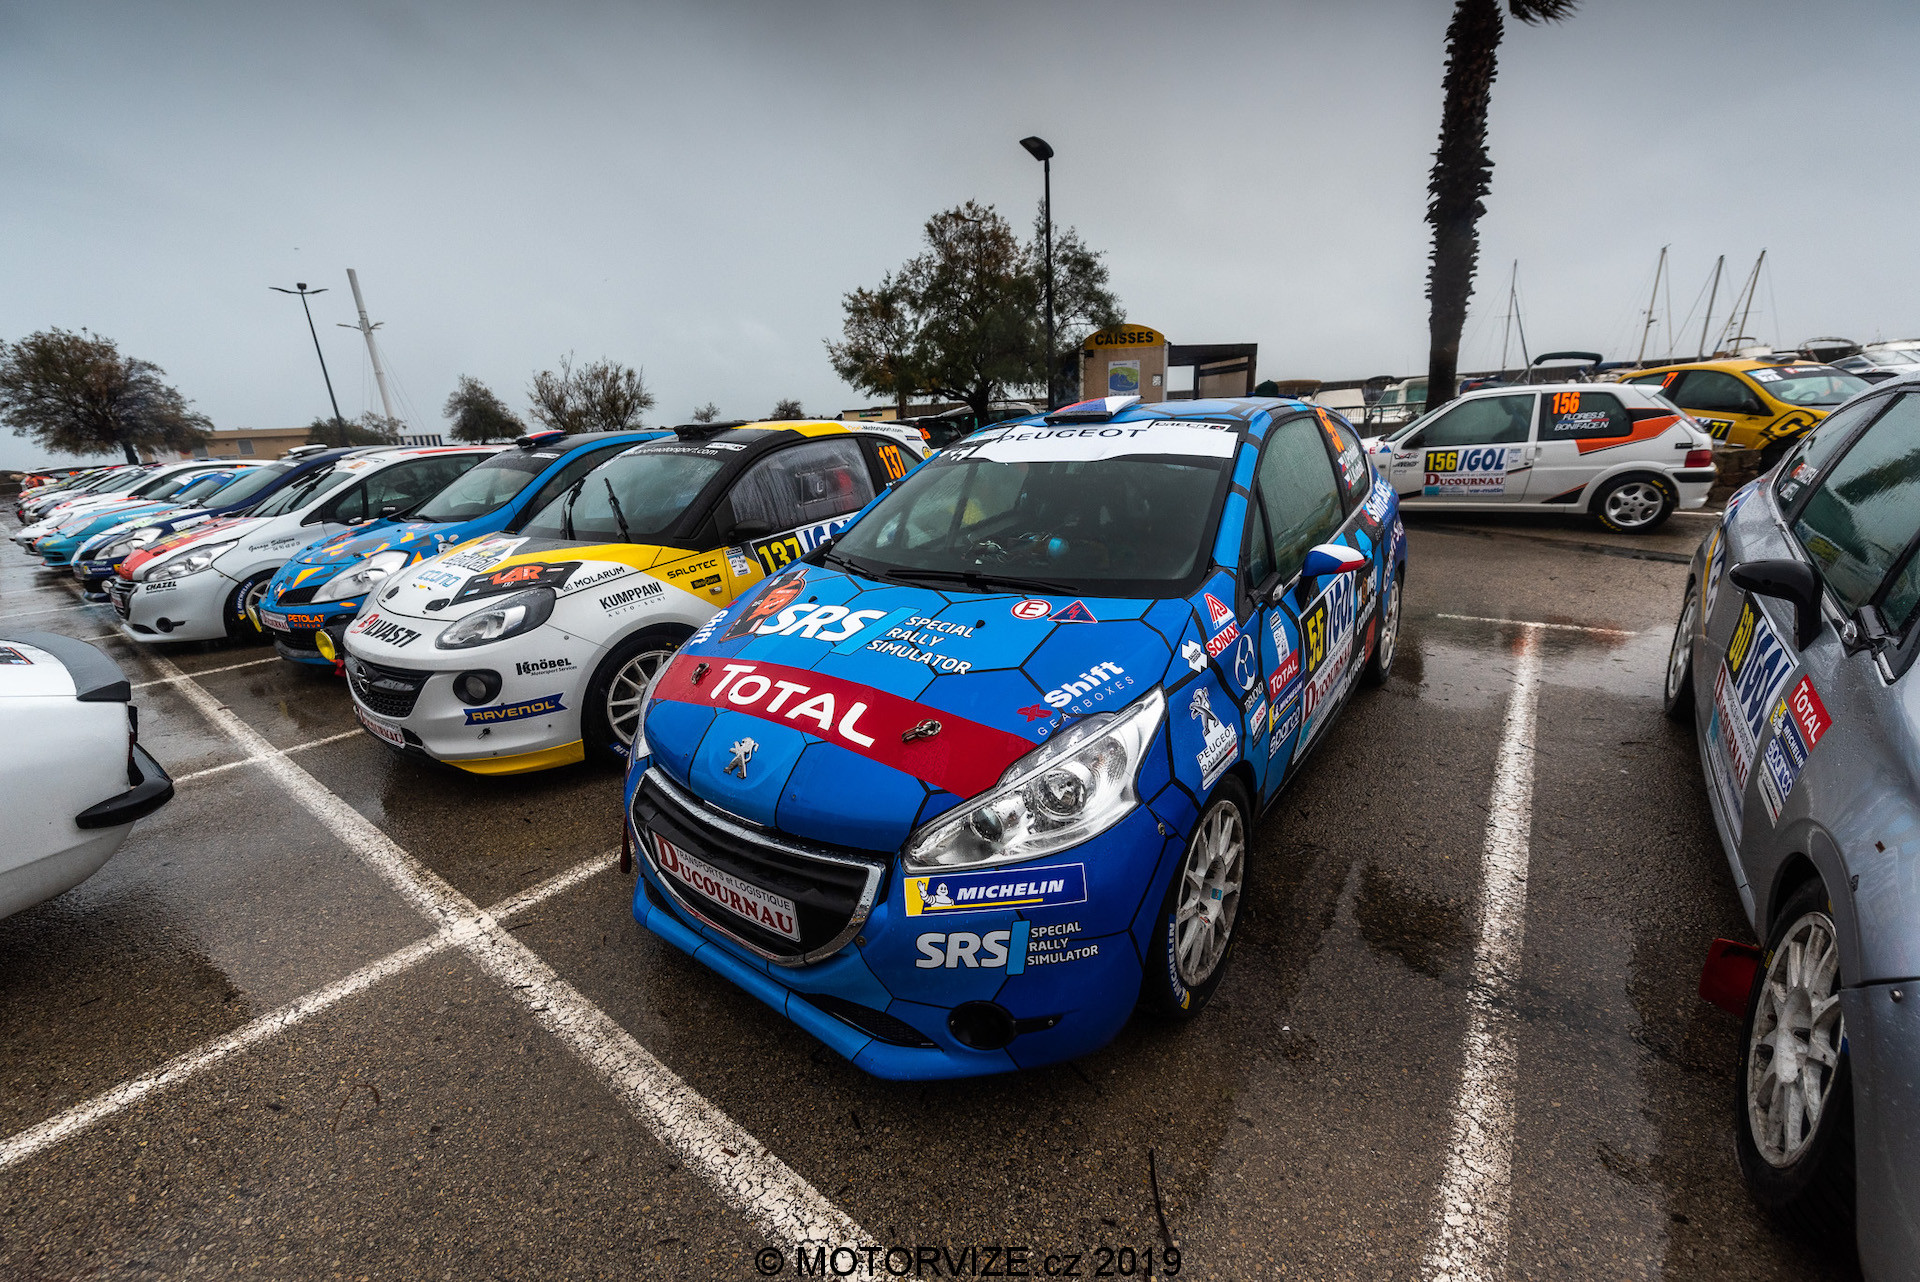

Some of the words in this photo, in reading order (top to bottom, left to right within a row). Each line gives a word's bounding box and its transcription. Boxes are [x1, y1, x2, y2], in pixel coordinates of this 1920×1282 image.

[1095, 331, 1154, 346] CAISSES
[1553, 392, 1580, 415] 156
[998, 428, 1148, 443] PEUGEOT
[1711, 421, 1729, 439] 77
[878, 445, 906, 480] 137
[1427, 452, 1458, 472] 156
[1459, 449, 1506, 472] IGOL
[1425, 473, 1505, 486] DUCOURNAU
[667, 559, 718, 579] SALOTEC
[758, 536, 801, 575] 137
[146, 581, 177, 591] CHAZEL
[574, 566, 625, 588] MOLARUM
[599, 581, 662, 610] KUMPPANI
[1019, 602, 1044, 616] E
[287, 614, 325, 623] PETOLAT
[756, 603, 888, 642] SRS
[904, 616, 976, 639] SPECIAL
[885, 628, 945, 648] RALLY
[1206, 622, 1240, 658] SONAX
[1306, 606, 1324, 673] 55
[866, 640, 973, 676] SIMULATOR
[1044, 661, 1125, 708] Shift
[1271, 659, 1298, 694] TOTAL
[472, 701, 556, 721] RAVENOL
[710, 663, 875, 748] TOTAL
[1037, 676, 1134, 736] GEARBOXES
[1794, 681, 1822, 744] TOTAL
[1198, 723, 1234, 764] PEUGEOT
[1270, 705, 1300, 753] sparco
[1783, 724, 1804, 769] MICHELIN
[1767, 738, 1793, 797] sparco
[655, 833, 793, 934] DUCOURNAU
[676, 849, 724, 882] TRANSPORTS
[725, 876, 734, 886] et
[735, 879, 791, 911] LOGISTIQUE
[957, 879, 1065, 901] MICHELIN
[1030, 921, 1082, 938] SPECIAL
[915, 930, 1011, 969] SRS
[1026, 945, 1099, 966] SIMULATOR
[1029, 937, 1069, 952] RALLY
